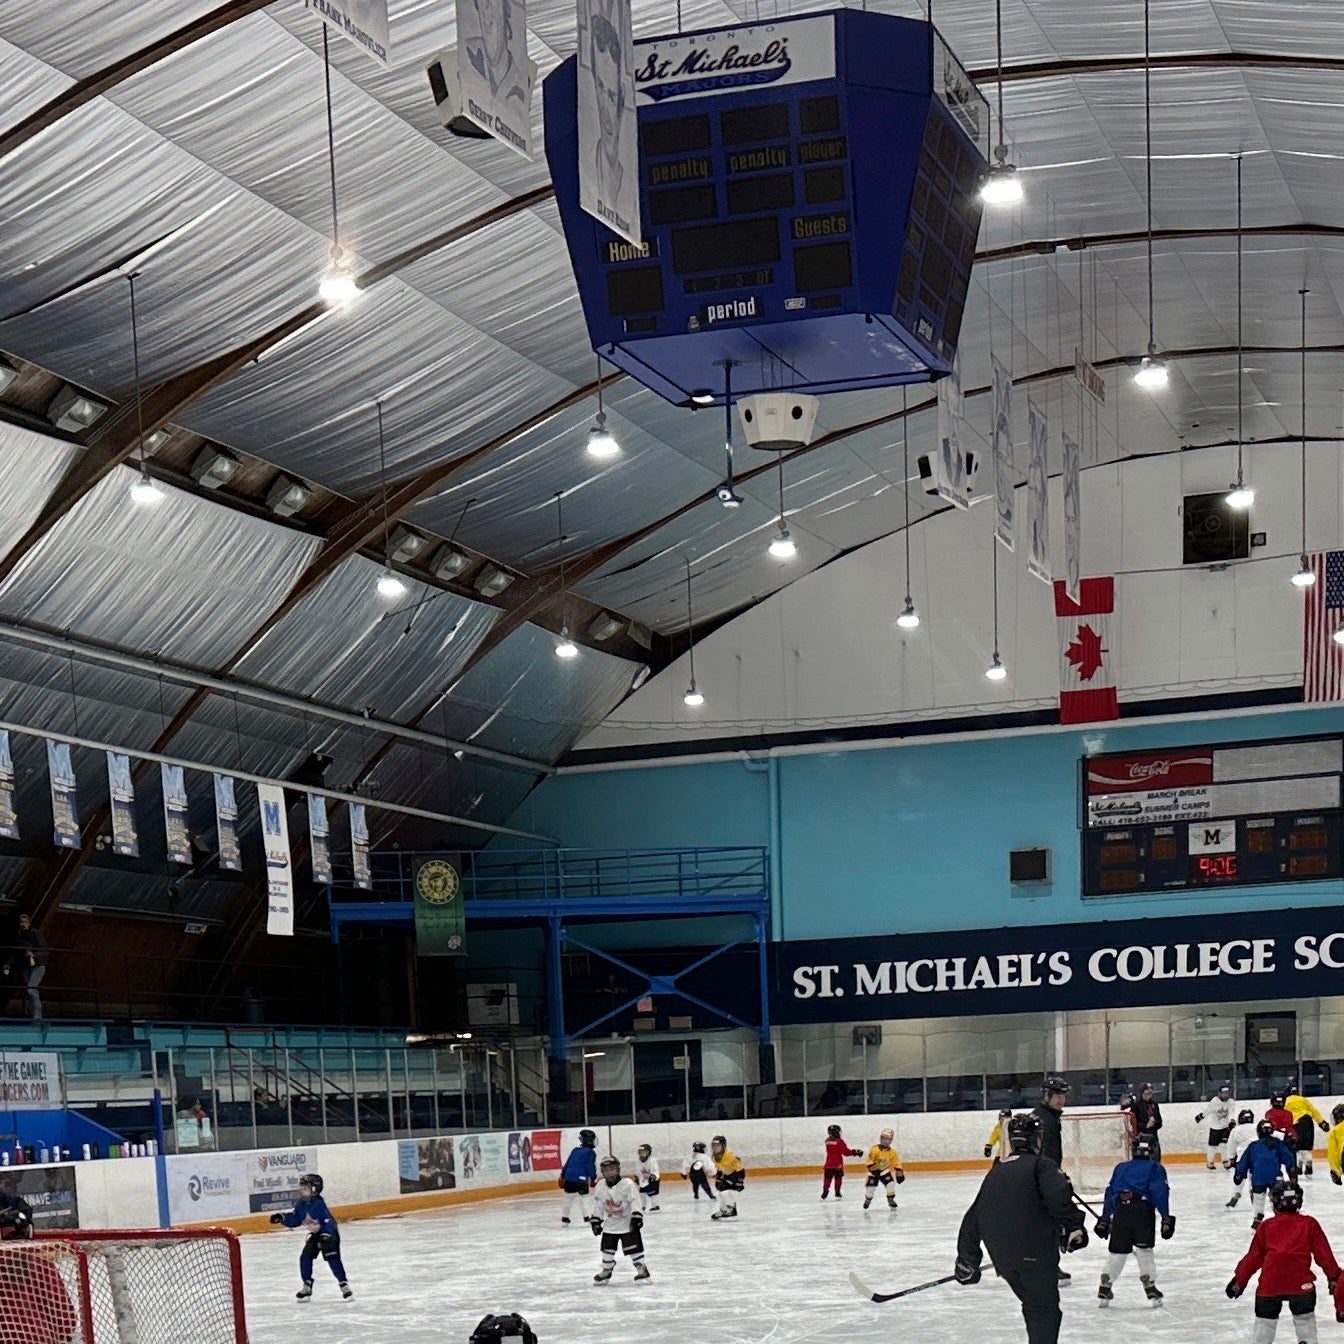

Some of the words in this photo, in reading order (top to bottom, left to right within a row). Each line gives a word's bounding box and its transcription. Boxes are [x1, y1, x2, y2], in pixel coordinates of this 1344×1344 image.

[651, 25, 775, 50] TORONTO
[661, 72, 769, 97] MAJORS
[652, 159, 709, 183] penalty
[729, 146, 787, 173] penalty
[799, 139, 844, 164] player
[794, 214, 848, 239] Guests
[609, 241, 650, 262] Home
[707, 295, 756, 323] period
[264, 800, 281, 836] M
[1203, 829, 1222, 847] M
[792, 964, 844, 999] ST.
[852, 950, 1073, 996] MICHAEL'S
[1088, 938, 1276, 983] COLLEGE
[268, 1153, 306, 1167] VANGUARD
[202, 1175, 231, 1192] Revive
